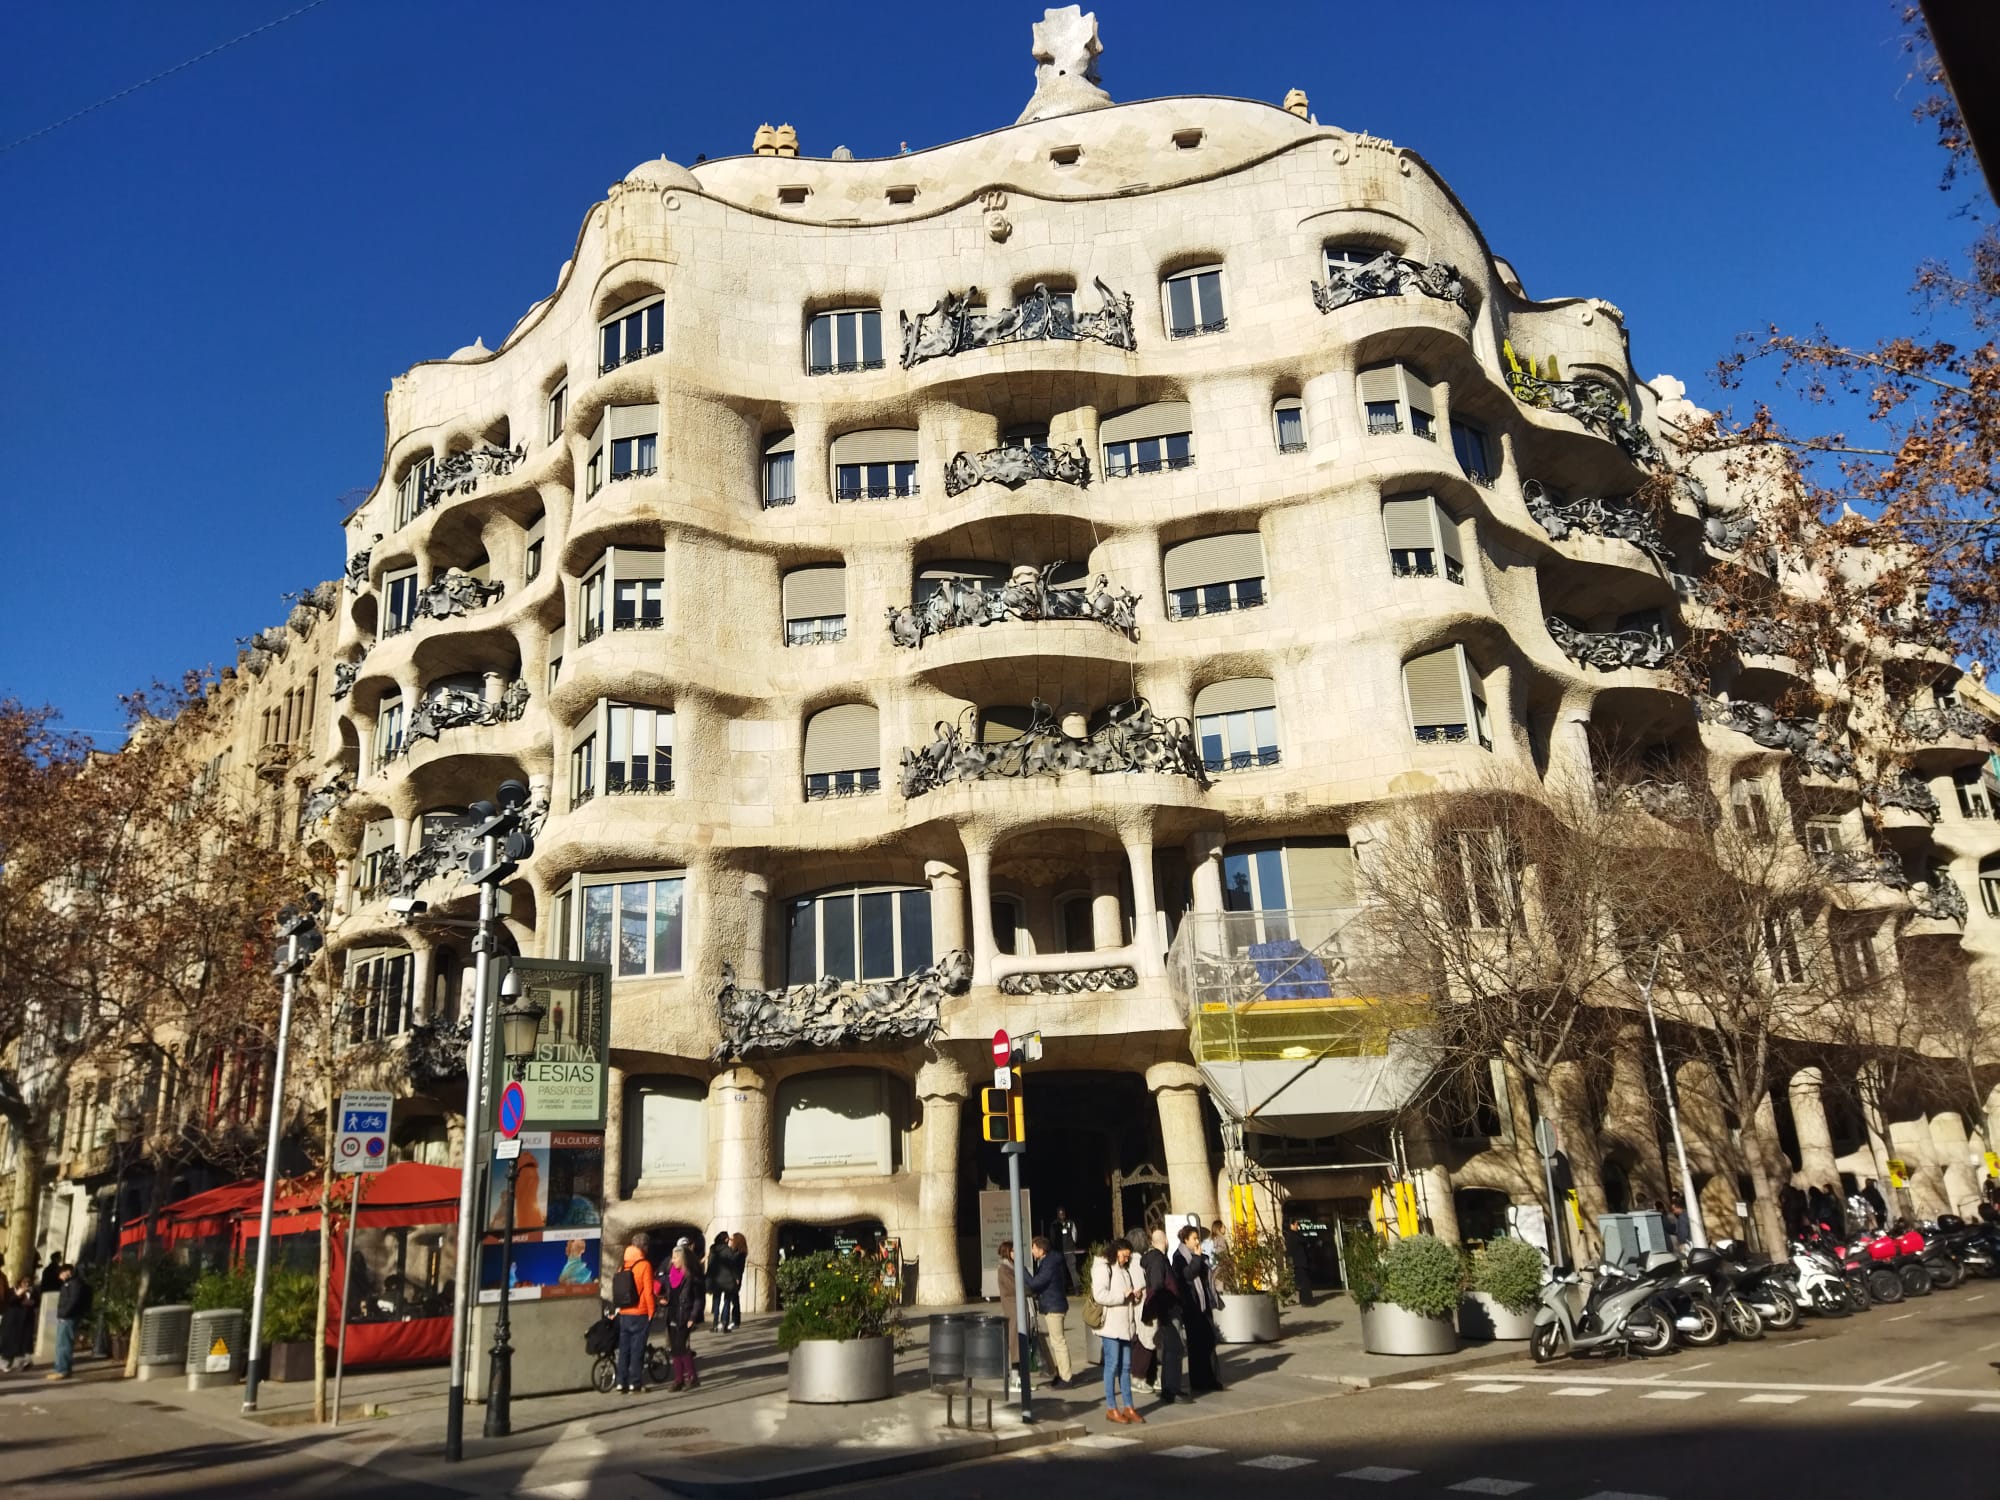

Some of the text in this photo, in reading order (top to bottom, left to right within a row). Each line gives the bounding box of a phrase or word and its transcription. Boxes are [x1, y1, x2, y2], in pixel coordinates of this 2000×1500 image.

[535, 1043, 596, 1063] ISTINA
[538, 1085, 594, 1096] PASSATGES
[553, 1136, 600, 1145] ALL CULTURE
[346, 1143, 355, 1151] 10
